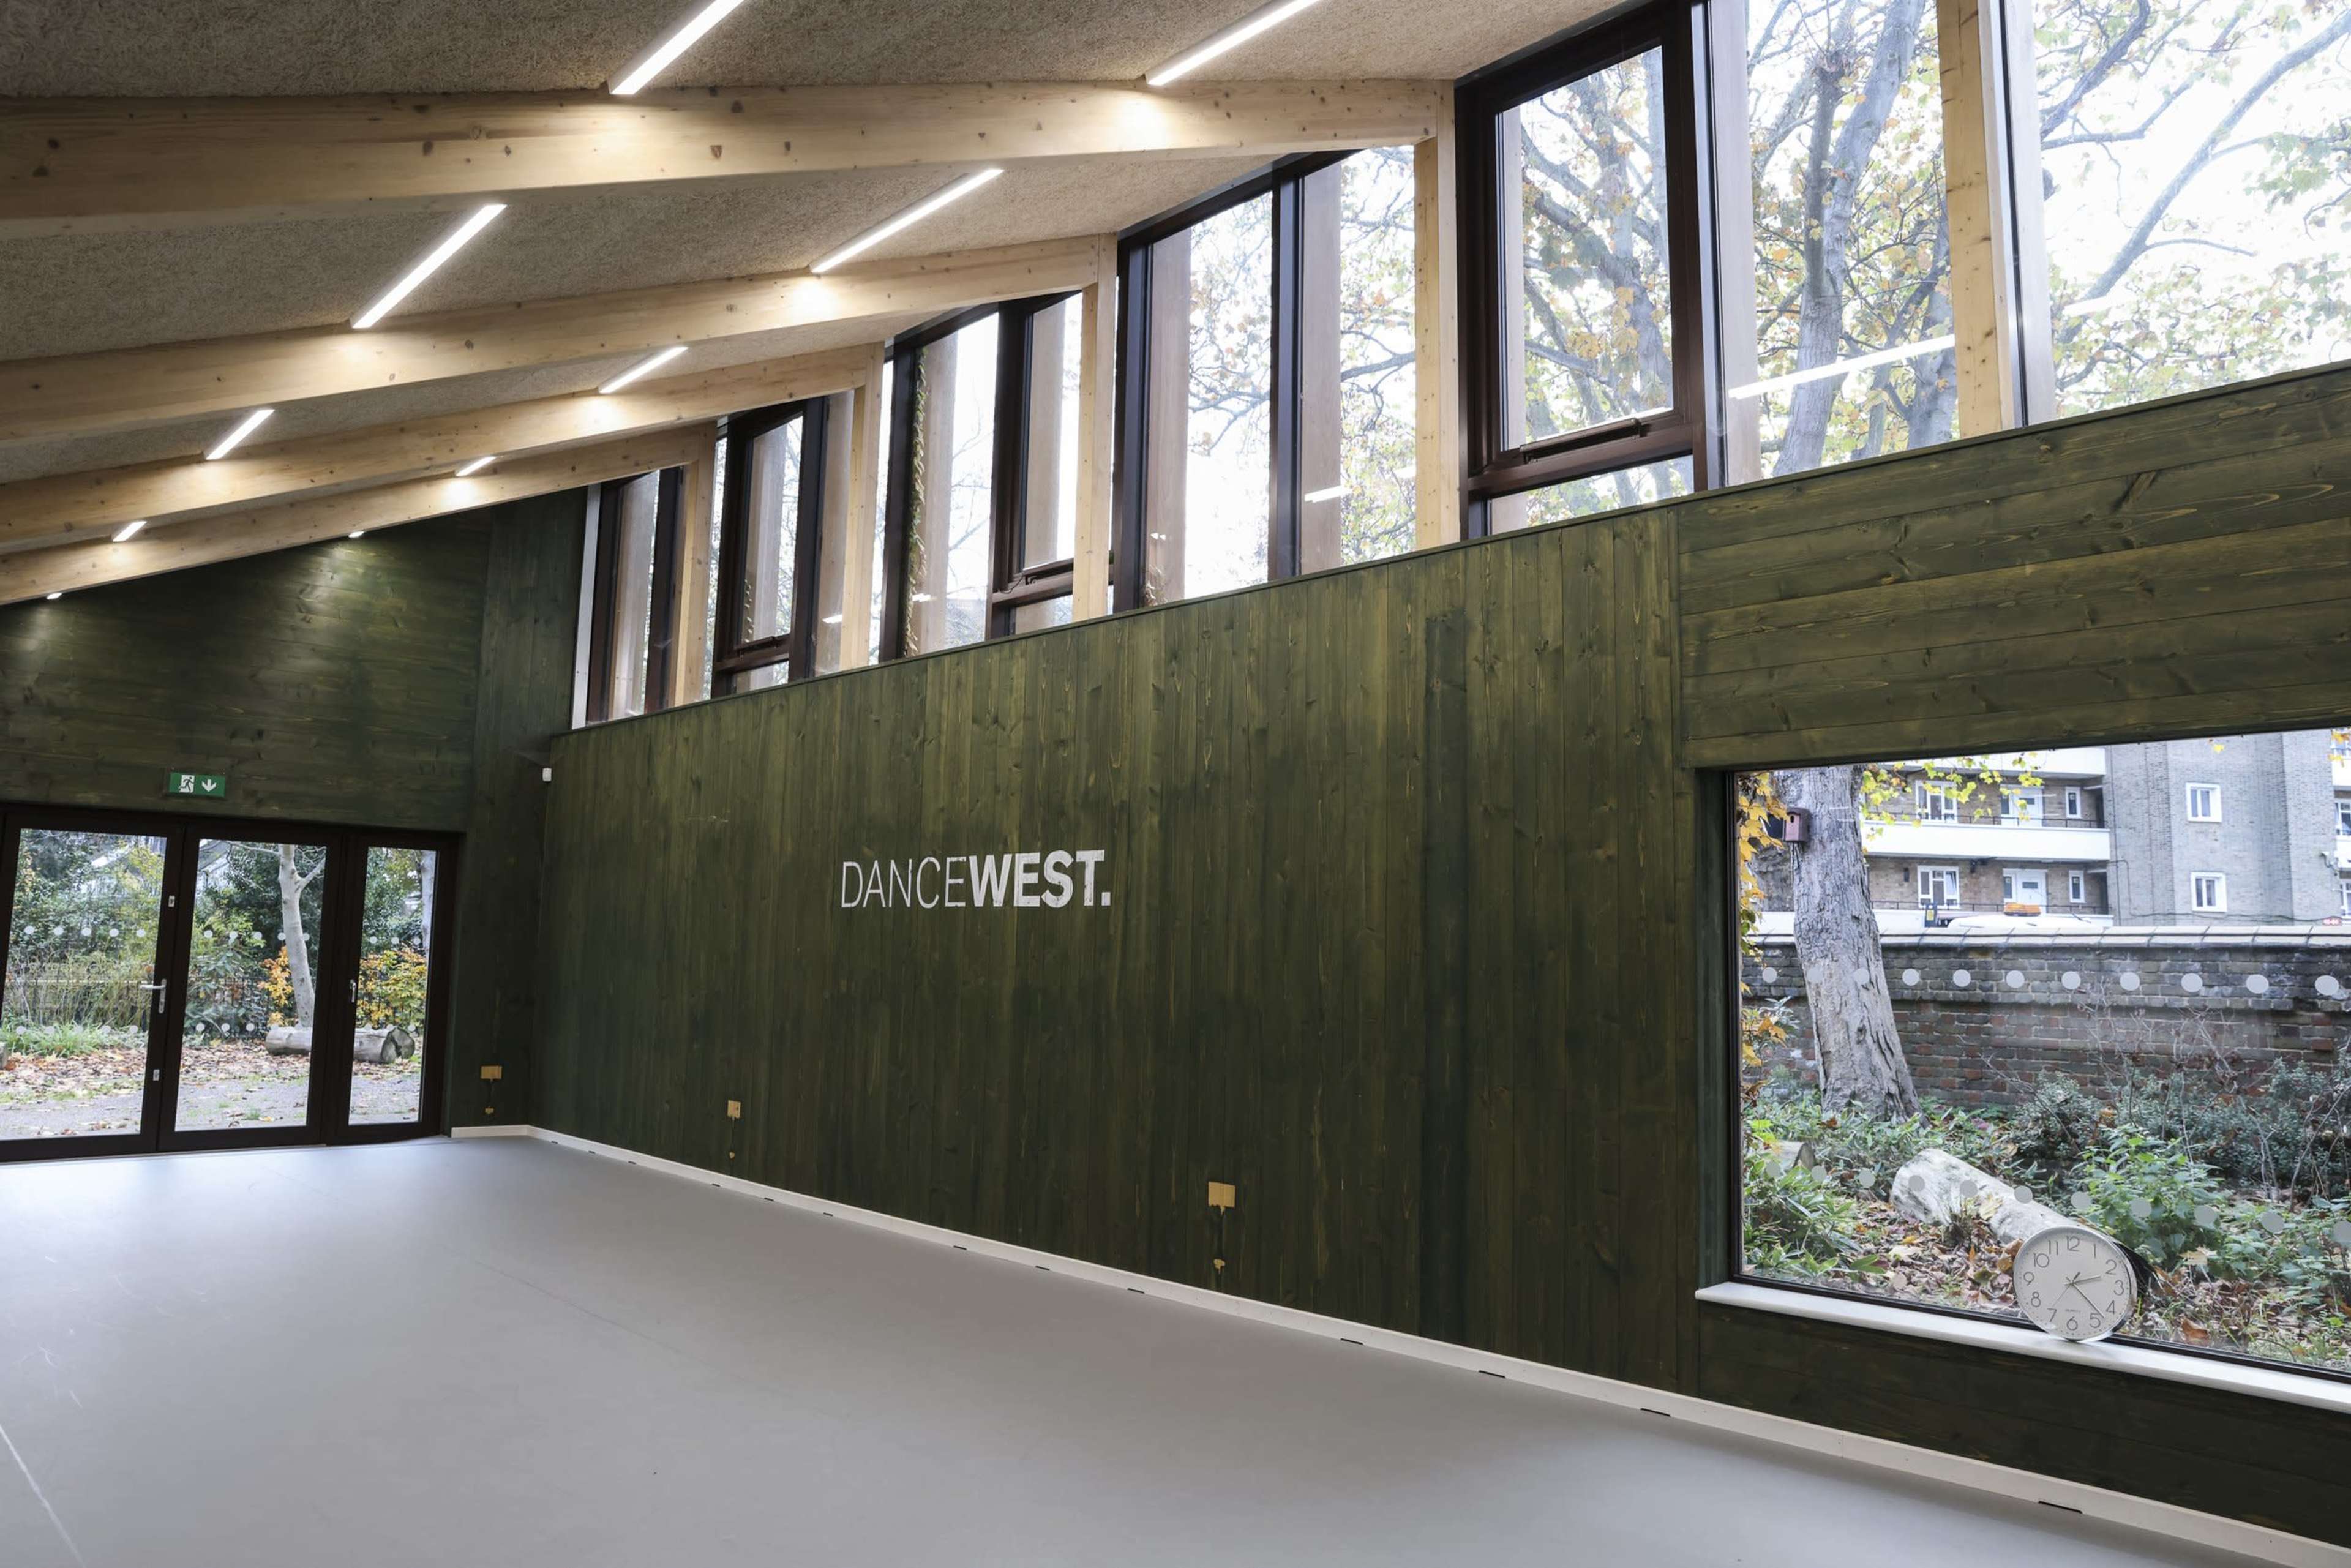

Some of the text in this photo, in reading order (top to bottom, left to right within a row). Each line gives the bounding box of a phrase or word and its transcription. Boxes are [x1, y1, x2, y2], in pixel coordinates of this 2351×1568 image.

[841, 849, 1111, 909] DANCEWEST.
[2048, 1240, 2058, 1255] 11
[2066, 1236, 2080, 1251] 12
[2033, 1252, 2050, 1268] 10
[2105, 1259, 2117, 1275] 2
[2023, 1271, 2035, 1286] 9
[2113, 1280, 2124, 1296] 3
[2030, 1291, 2041, 1308] 8
[2105, 1299, 2115, 1315] 4
[2047, 1308, 2058, 1323] 7
[2066, 1316, 2079, 1331] 6
[2089, 1313, 2101, 1329] 5
